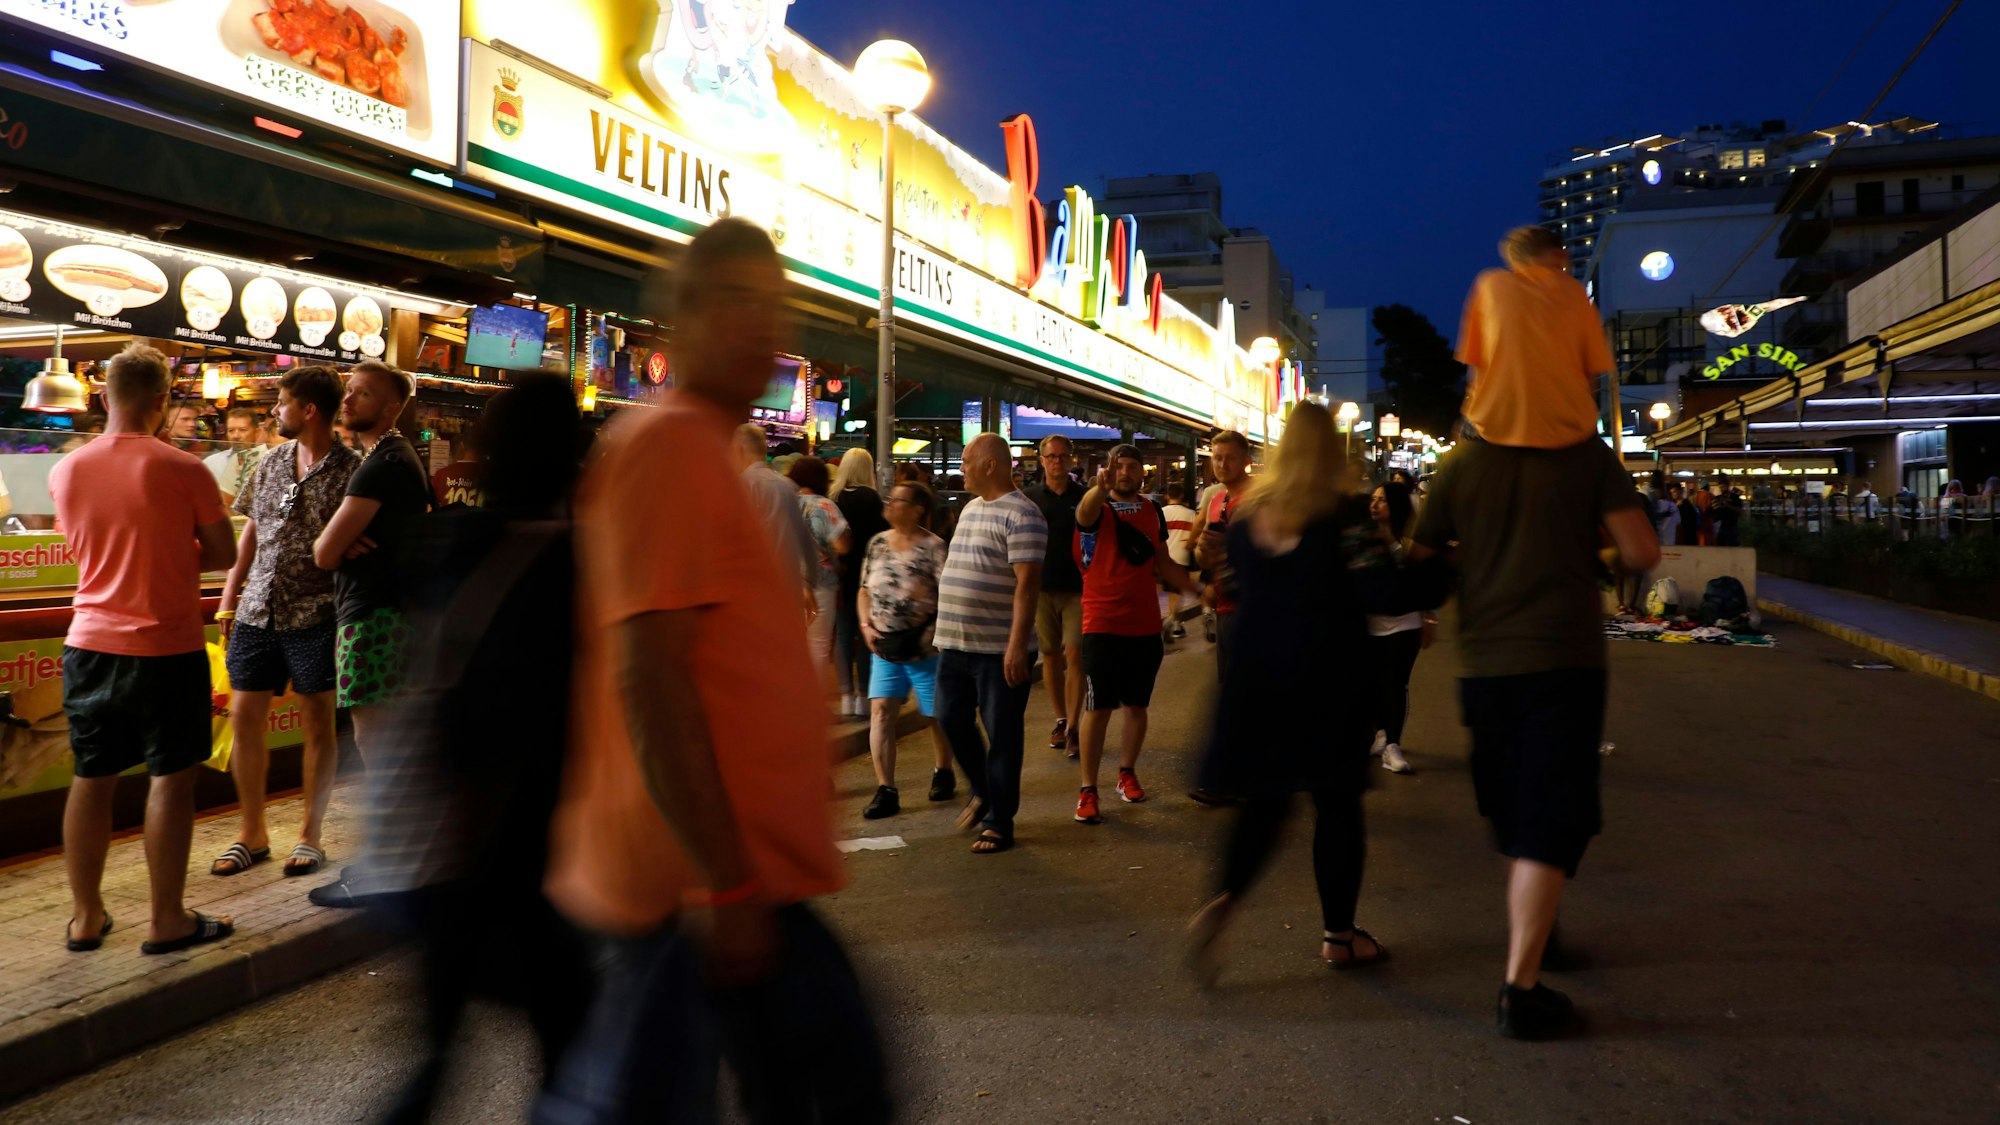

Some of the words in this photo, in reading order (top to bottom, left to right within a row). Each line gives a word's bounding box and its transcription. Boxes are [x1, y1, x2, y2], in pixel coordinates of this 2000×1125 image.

[590, 109, 732, 219] VELTINS
[893, 247, 953, 305] ELTINS
[74, 312, 90, 323] Mit
[91, 315, 132, 329] Brötchen
[175, 327, 190, 337] Mit
[191, 330, 227, 342] Brötchen
[235, 335, 248, 345] Mit
[249, 337, 282, 350] Brötchen
[1702, 343, 1750, 380] SAN
[0, 543, 76, 568] aschlik
[9, 570, 39, 579] SOSSE
